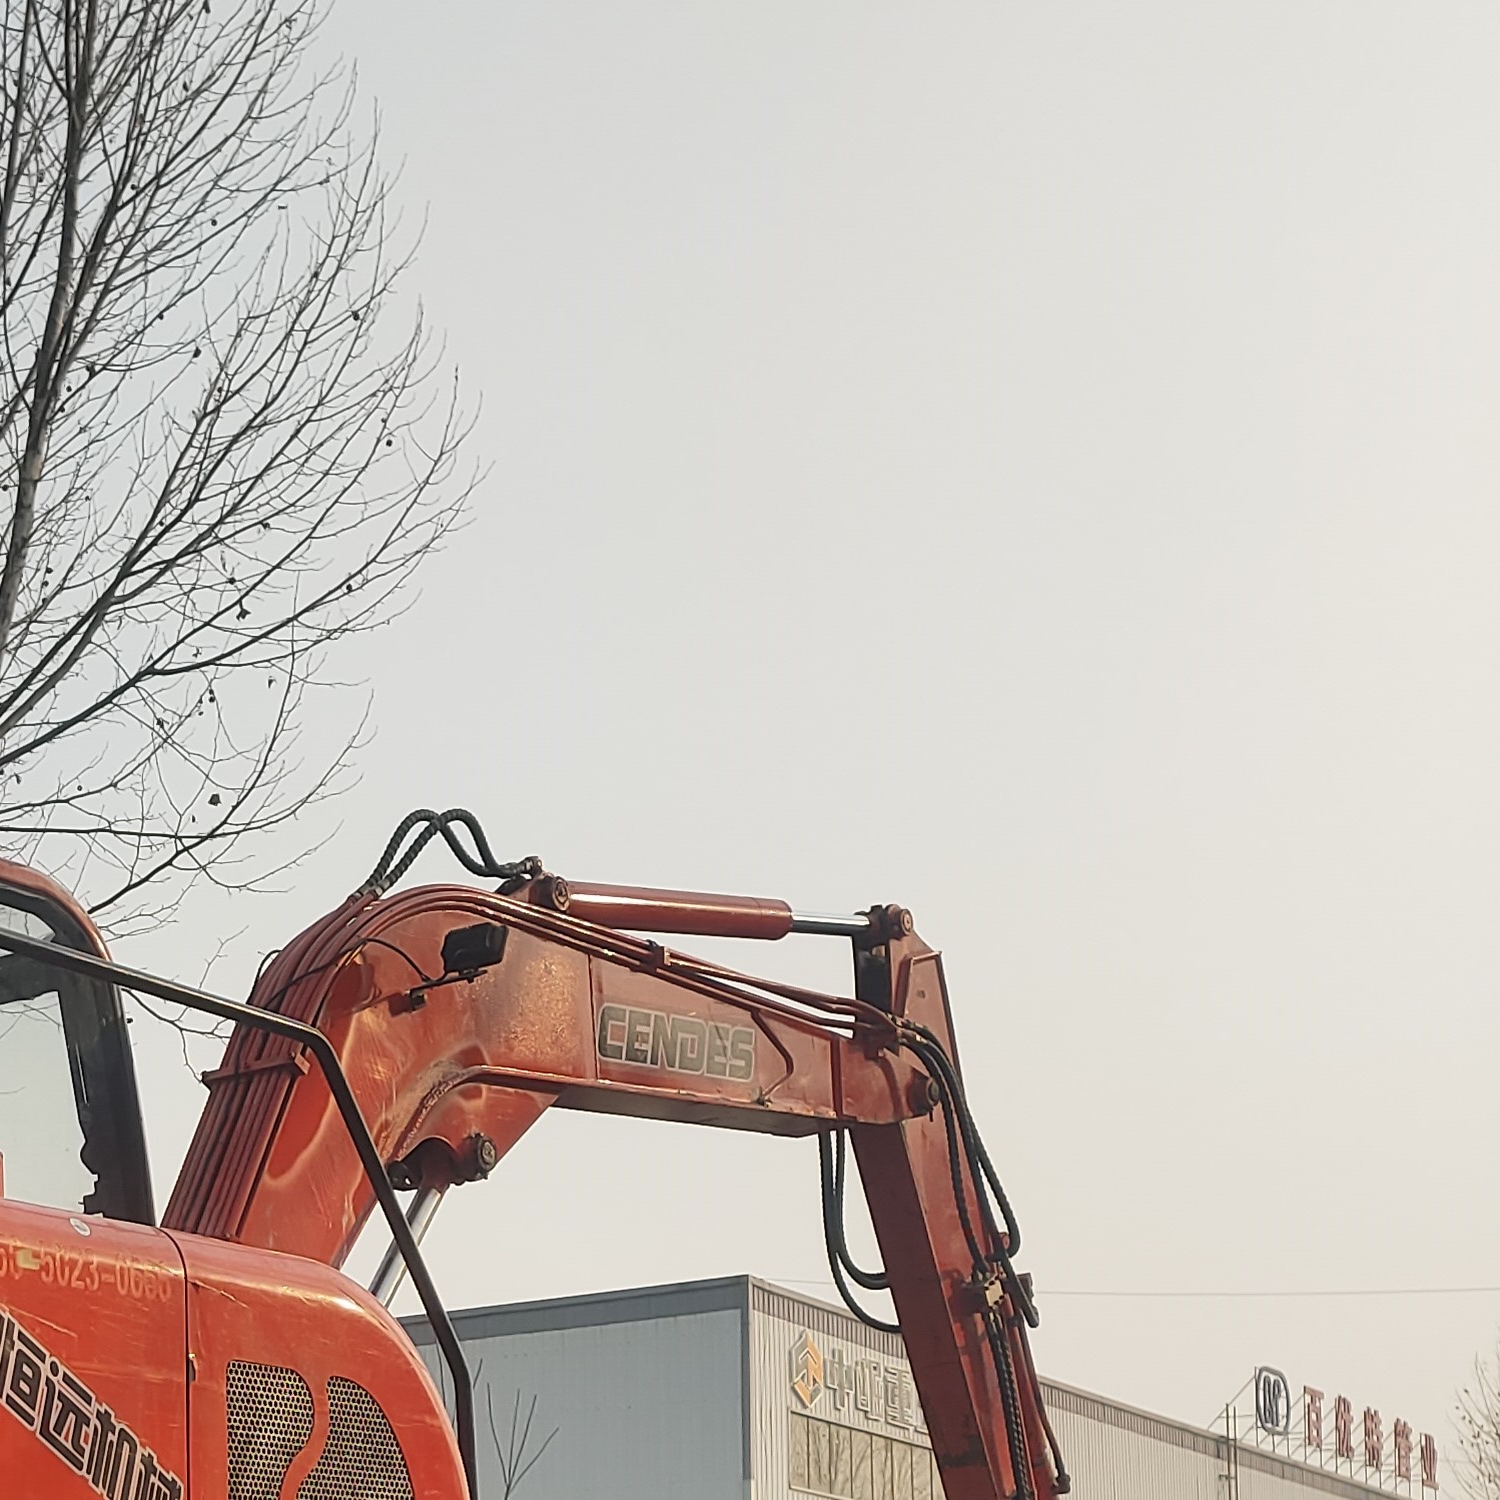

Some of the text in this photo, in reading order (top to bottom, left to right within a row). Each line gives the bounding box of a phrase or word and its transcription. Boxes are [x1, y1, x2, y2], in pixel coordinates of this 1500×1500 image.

[597, 1003, 755, 1082] CENDES
[1304, 1385, 1439, 1490] 百优特管业
